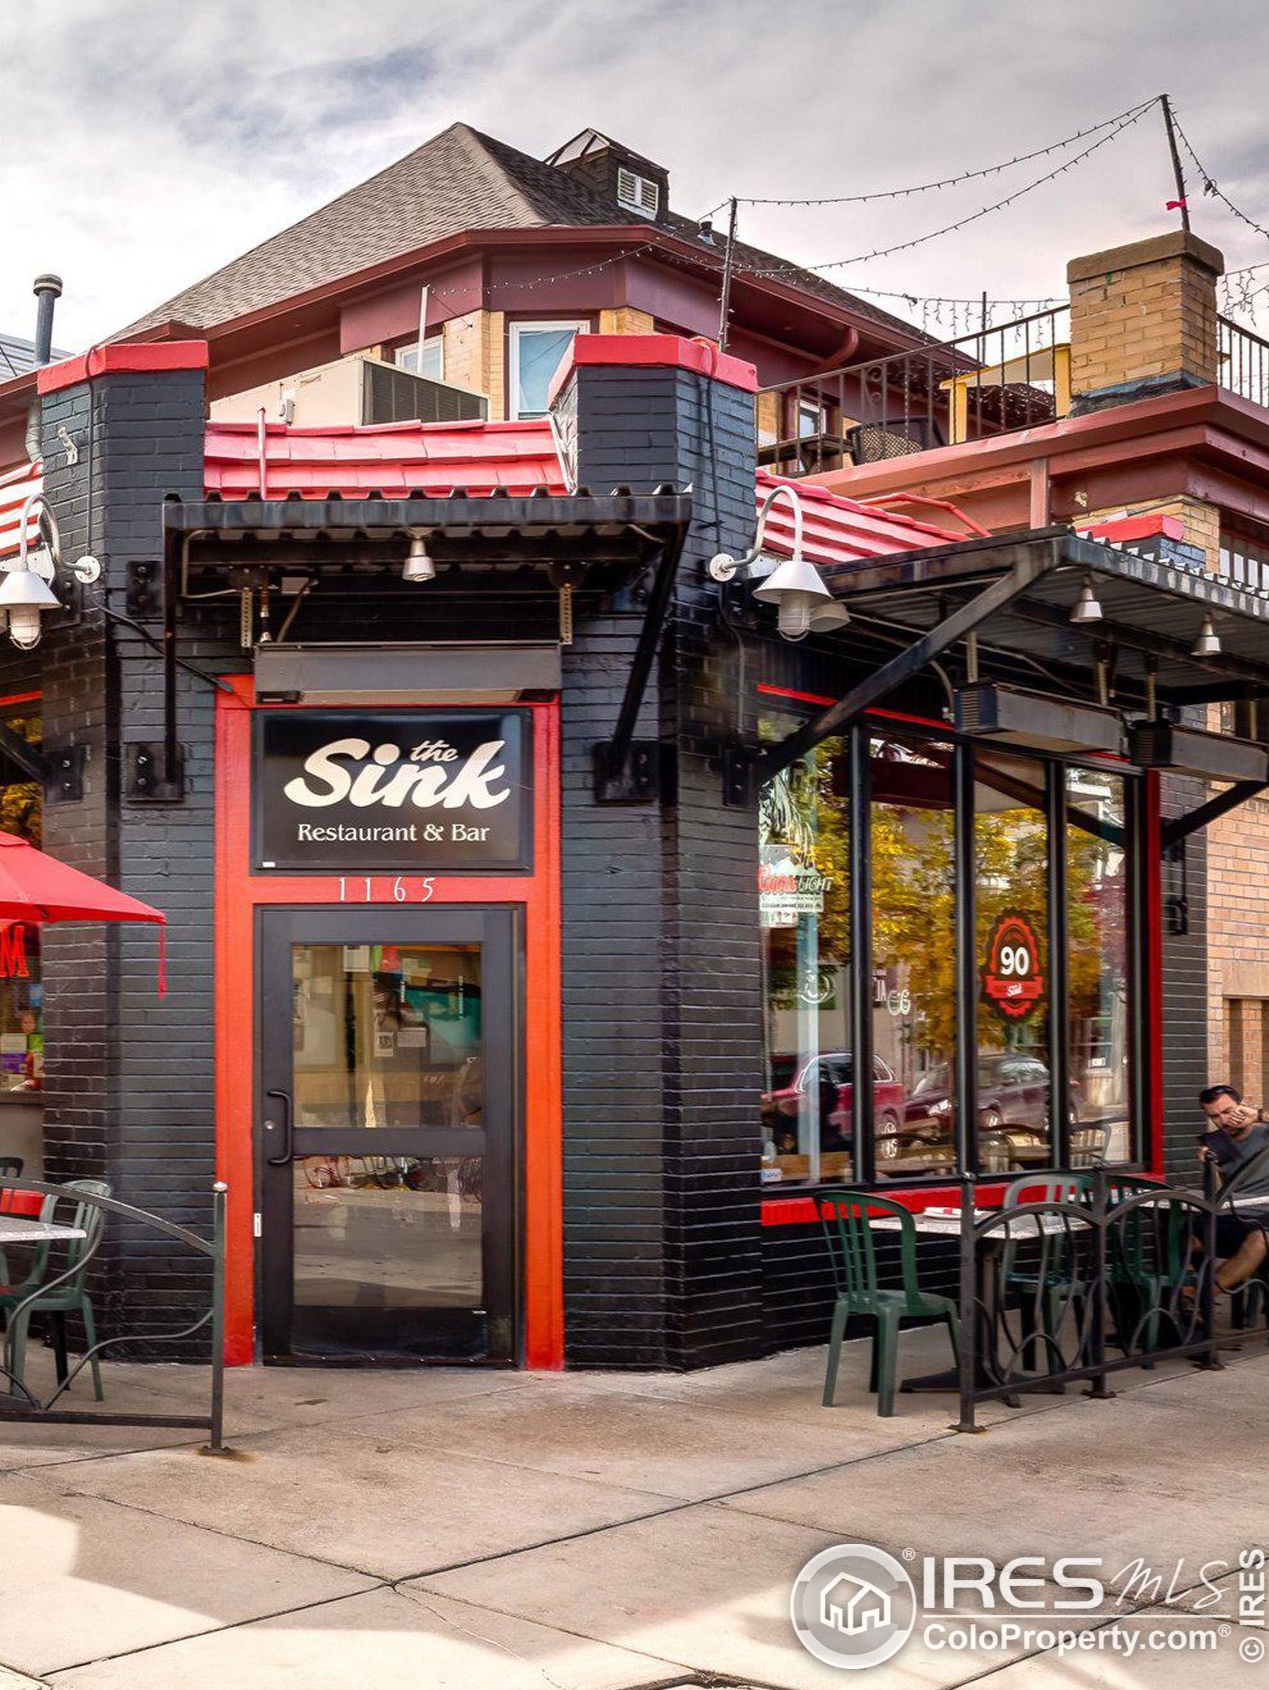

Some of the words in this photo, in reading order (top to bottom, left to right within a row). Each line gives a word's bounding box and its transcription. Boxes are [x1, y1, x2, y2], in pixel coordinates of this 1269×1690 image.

[409, 740, 459, 762] the
[283, 737, 511, 809] Sink
[297, 823, 417, 842] Restaurant
[423, 823, 445, 842] &
[451, 823, 490, 842] Bar
[338, 876, 437, 902] 1165
[1000, 946, 1030, 976] 90
